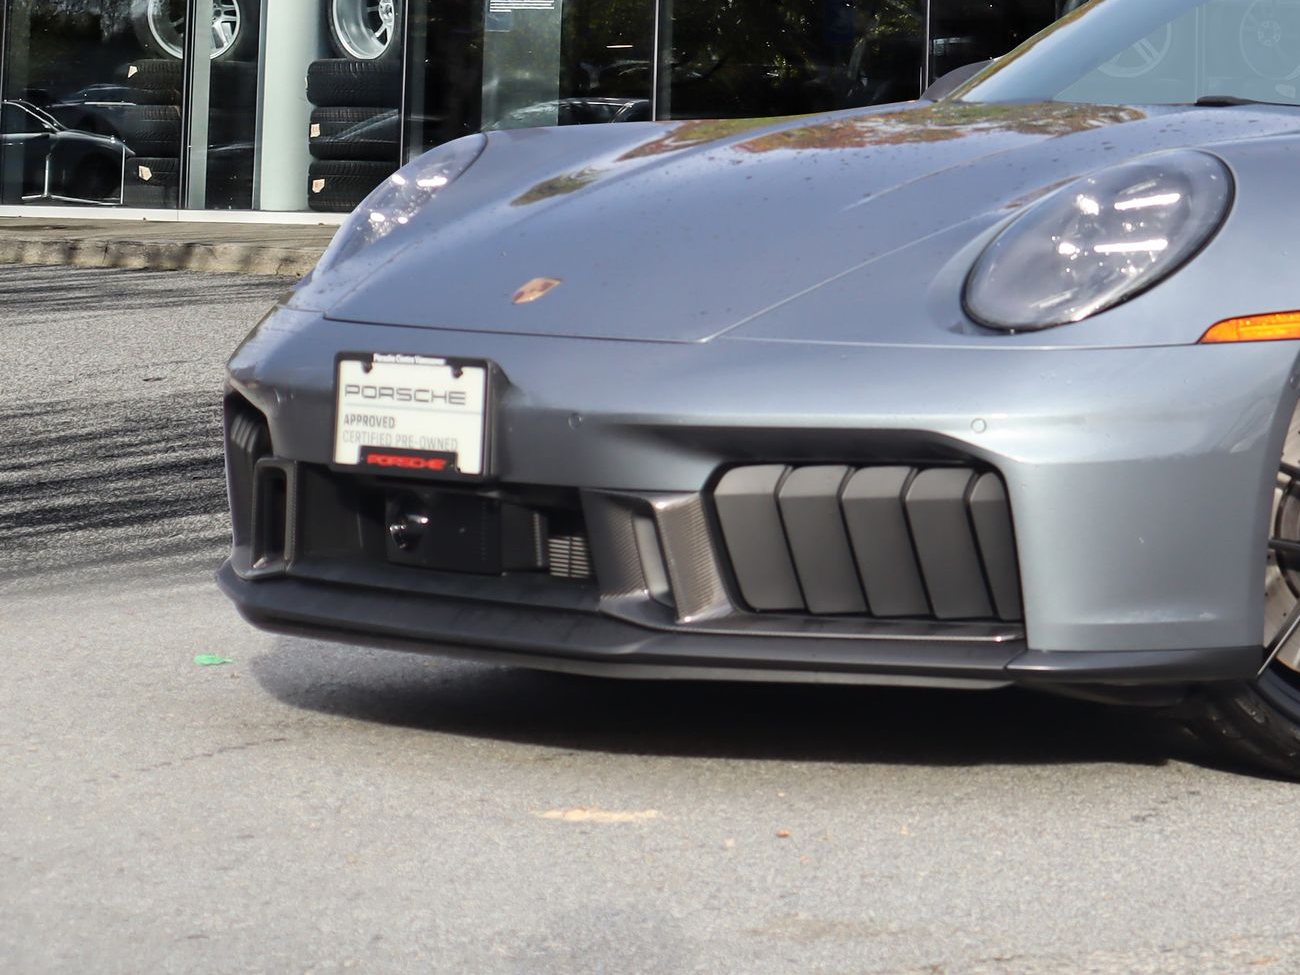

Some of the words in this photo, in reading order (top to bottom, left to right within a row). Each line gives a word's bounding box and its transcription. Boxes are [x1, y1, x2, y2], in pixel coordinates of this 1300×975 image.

[344, 384, 467, 406] PORSCHE
[343, 413, 396, 429] APPROVED
[342, 429, 393, 447] CERTIFIED
[394, 433, 459, 451] PRE-OWNED
